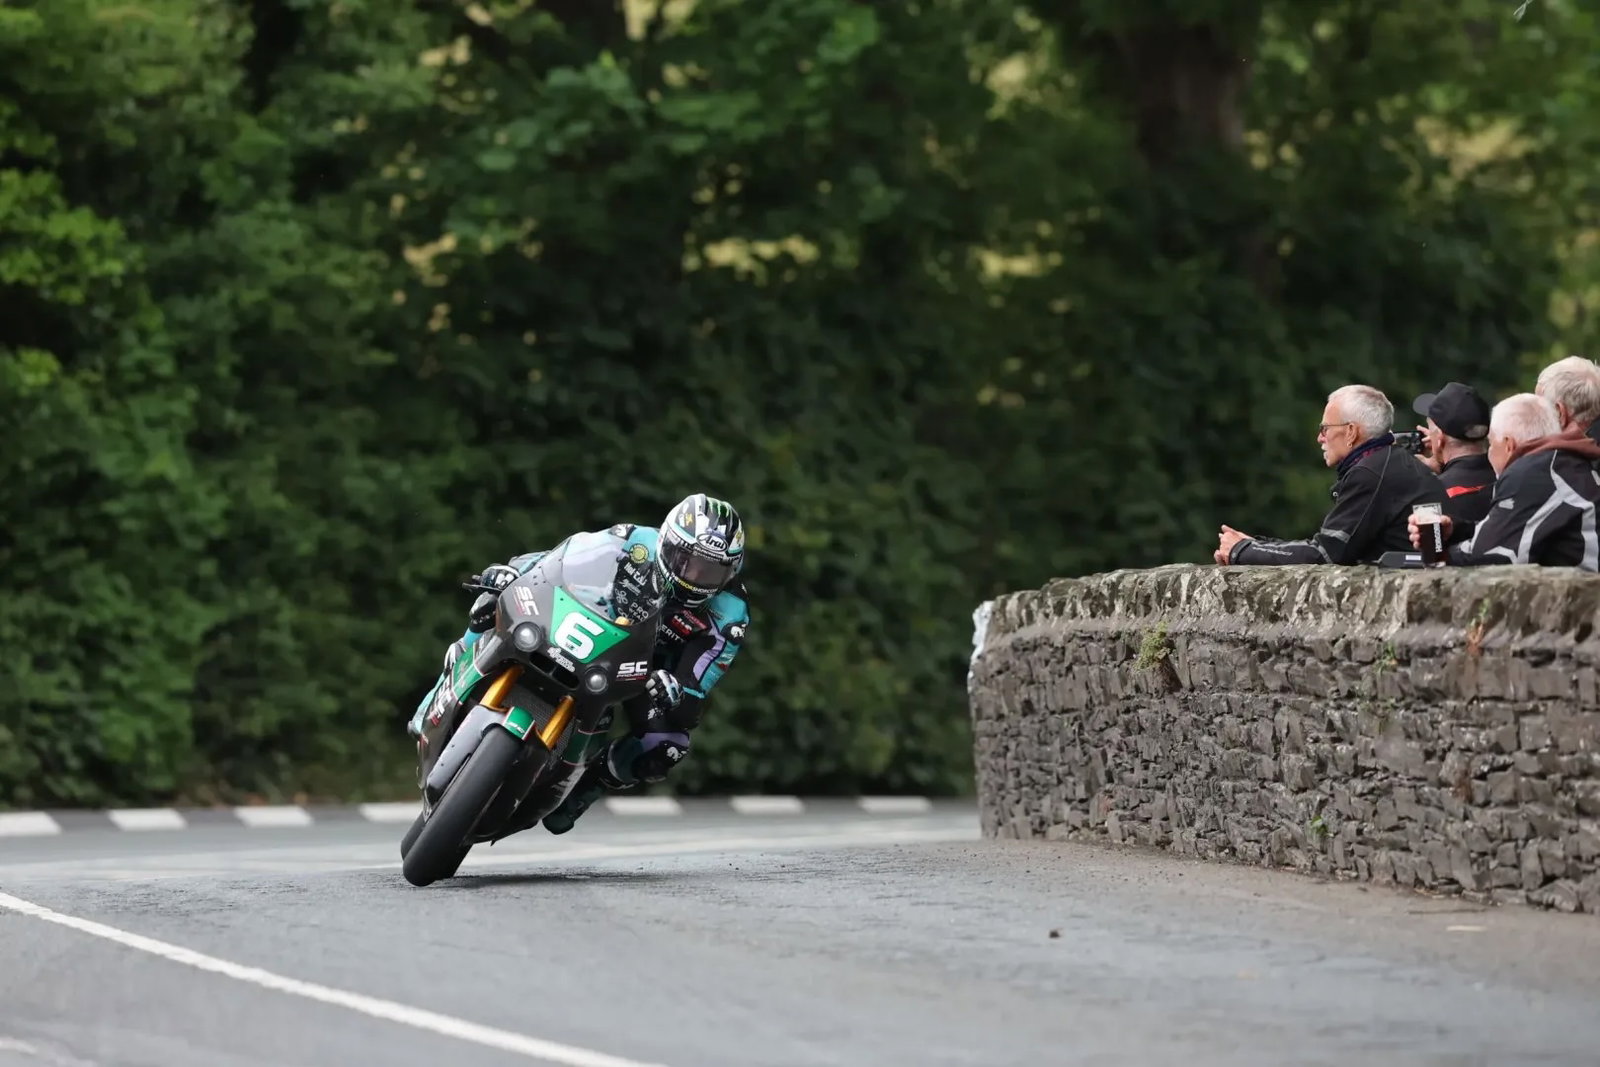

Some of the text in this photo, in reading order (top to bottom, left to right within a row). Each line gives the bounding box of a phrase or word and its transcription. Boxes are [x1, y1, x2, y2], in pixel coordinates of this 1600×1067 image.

[698, 535, 725, 550] Arai
[630, 602, 648, 618] PRO
[554, 611, 605, 660] 6
[617, 661, 647, 675] SC
